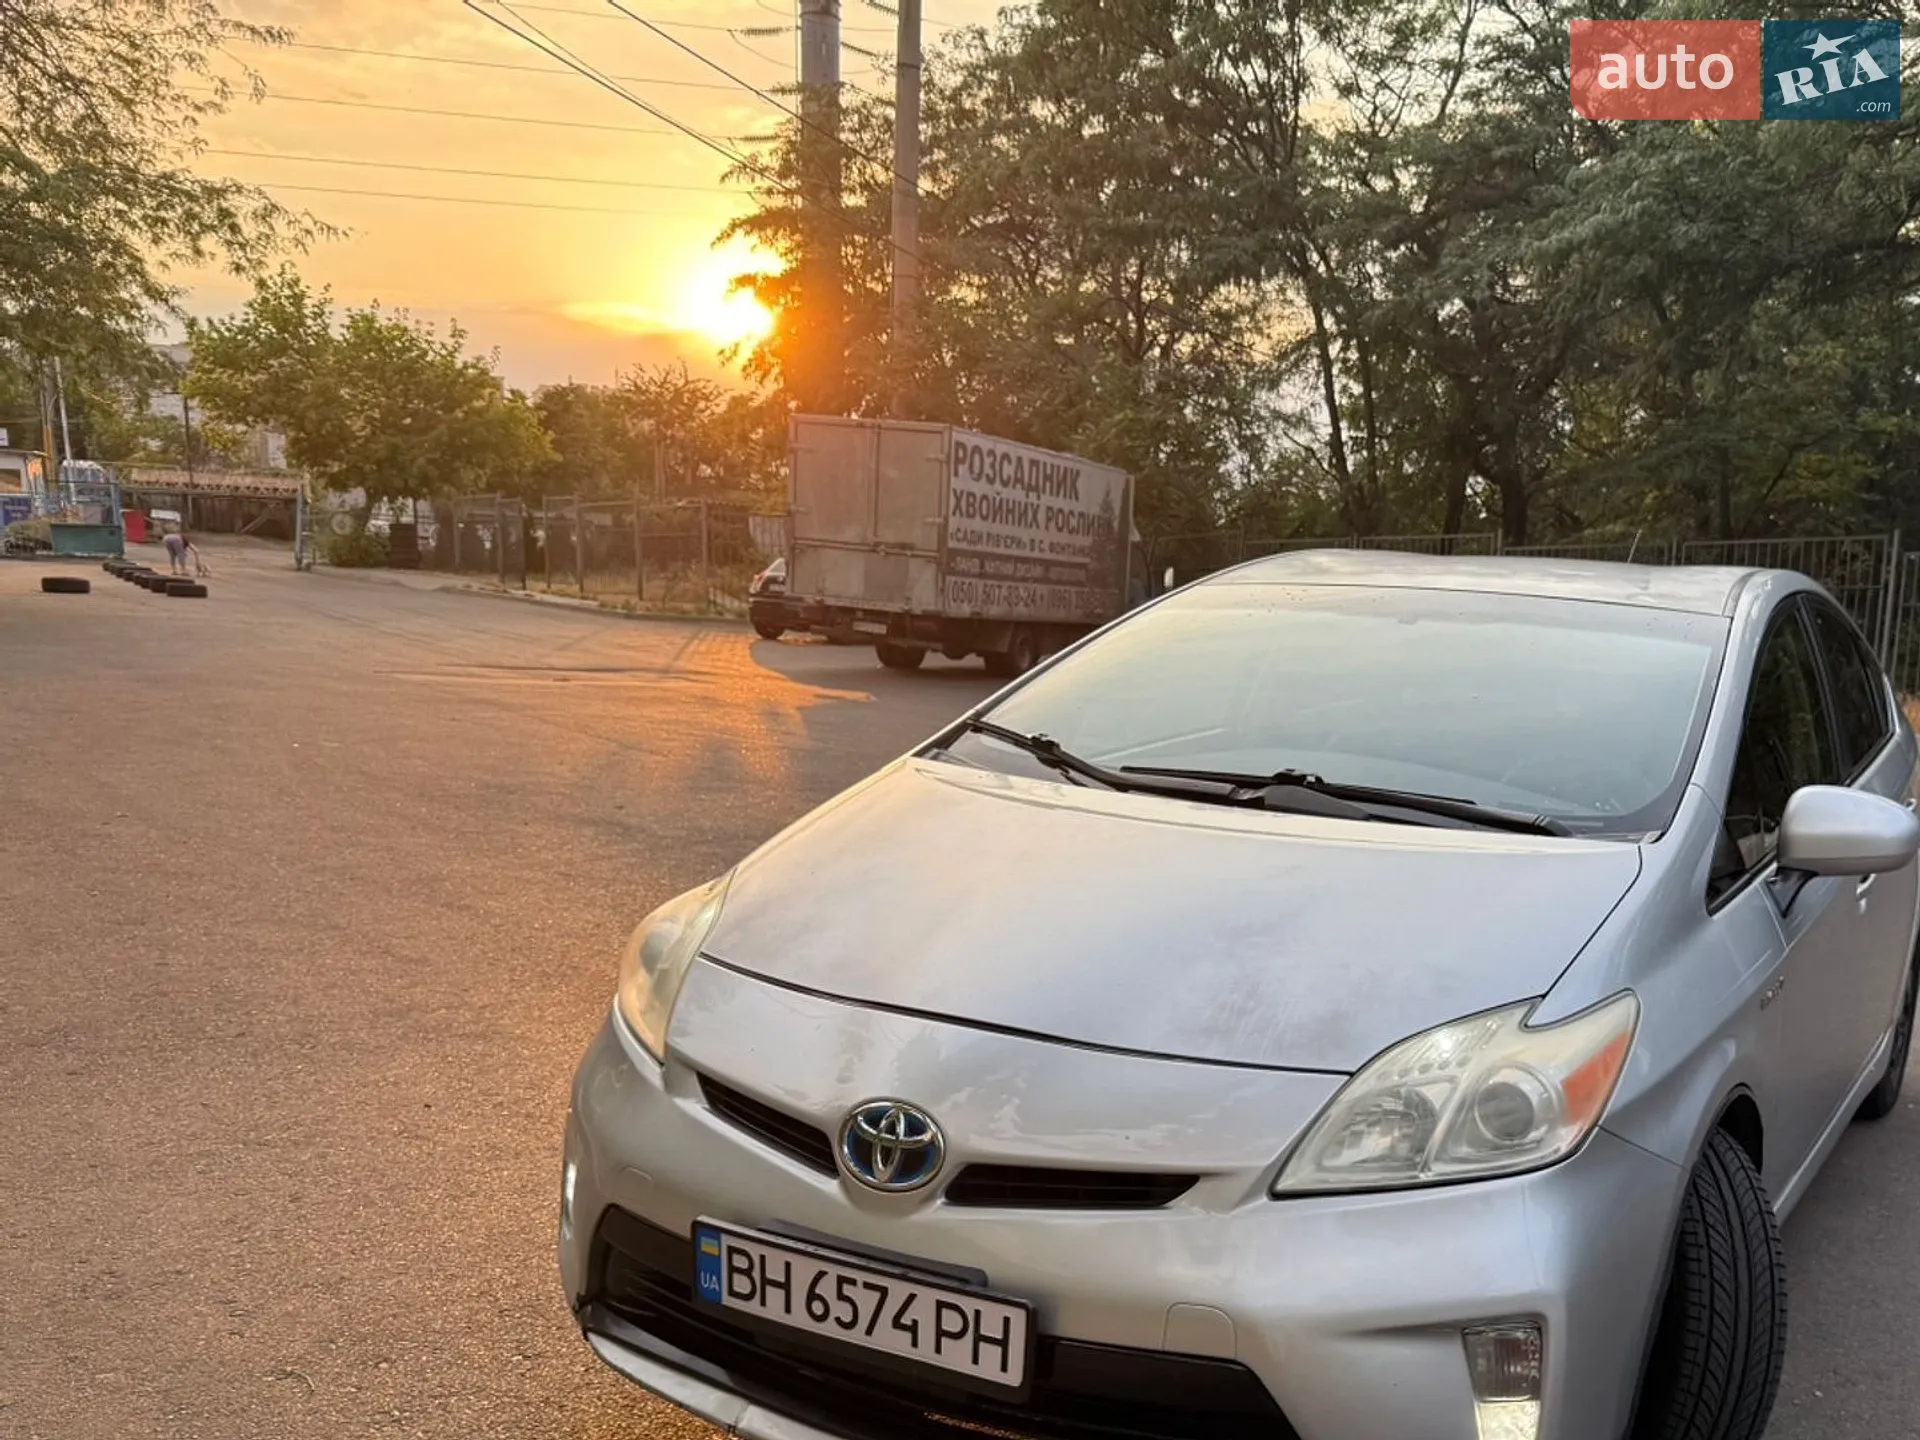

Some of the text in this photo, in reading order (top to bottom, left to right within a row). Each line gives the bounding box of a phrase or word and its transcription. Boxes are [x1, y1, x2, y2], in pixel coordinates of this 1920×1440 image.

[953, 440, 1081, 502] РОЗСАДНИК
[952, 488, 1040, 530] ХВОЙНИХ
[701, 1271, 720, 1292] UA
[726, 1245, 1010, 1373] BH 6574 PH
